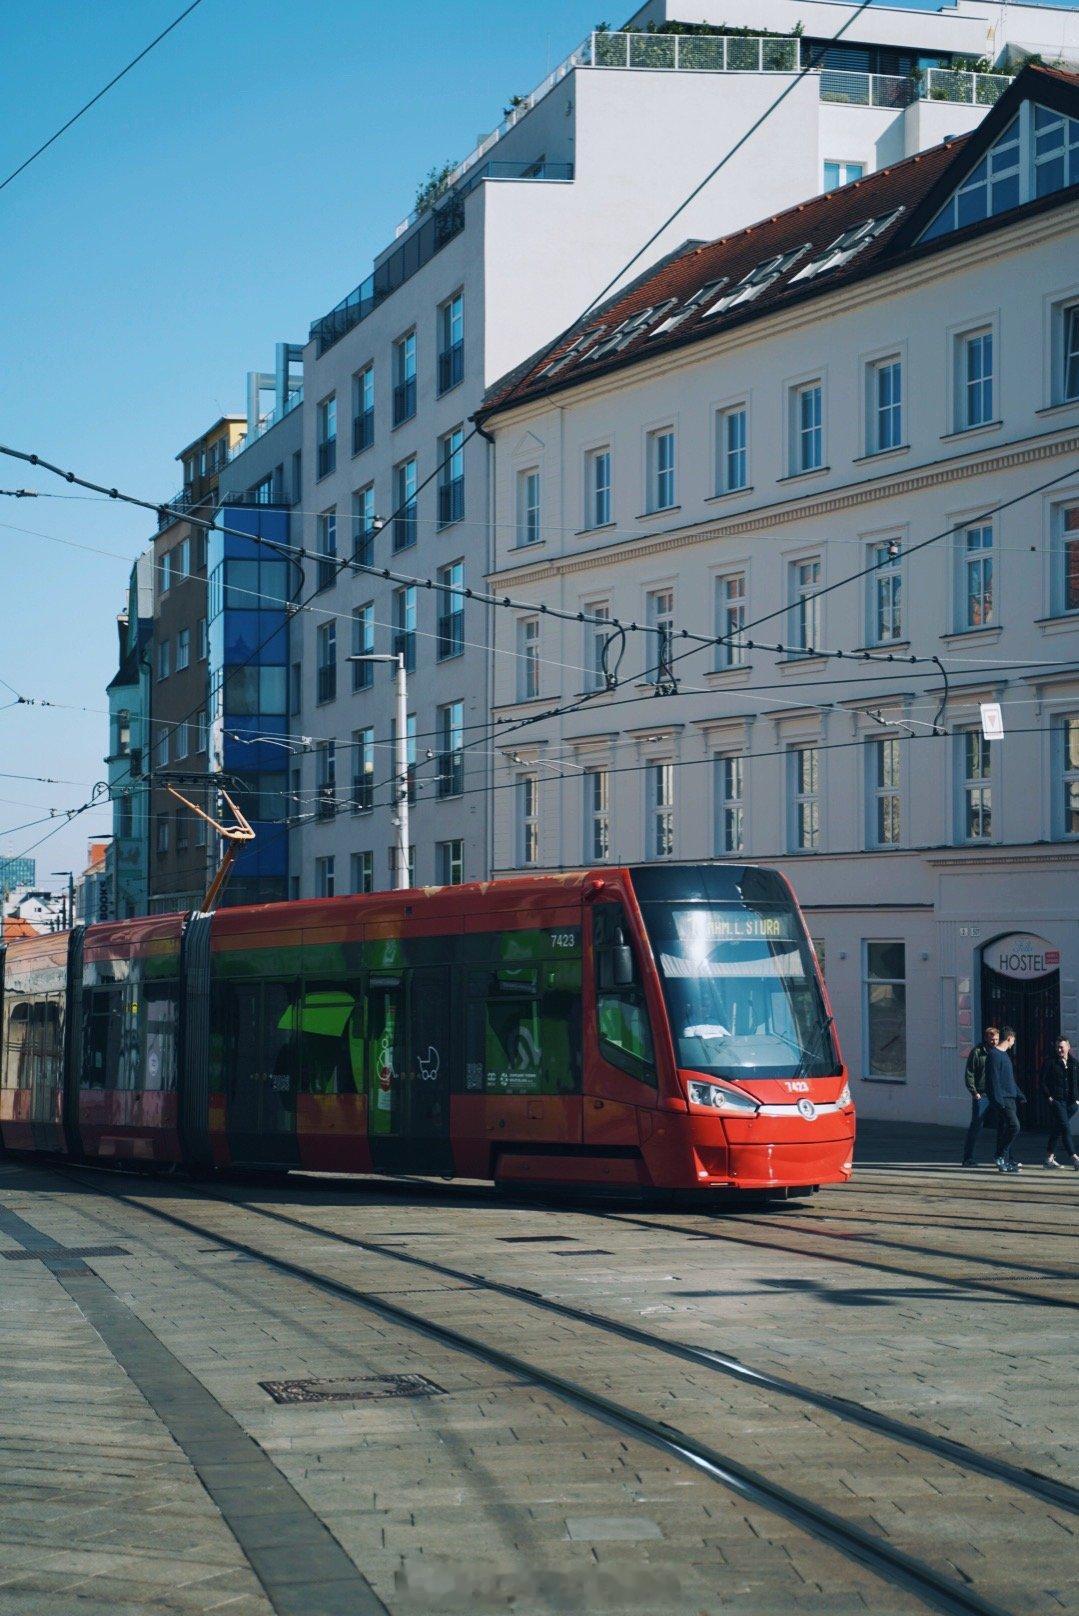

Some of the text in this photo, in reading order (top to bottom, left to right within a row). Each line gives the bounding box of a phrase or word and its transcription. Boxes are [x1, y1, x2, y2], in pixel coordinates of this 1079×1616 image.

[550, 934, 575, 948] 7423
[1000, 954, 1047, 971] HOSTEL
[784, 1081, 810, 1093] 7423
